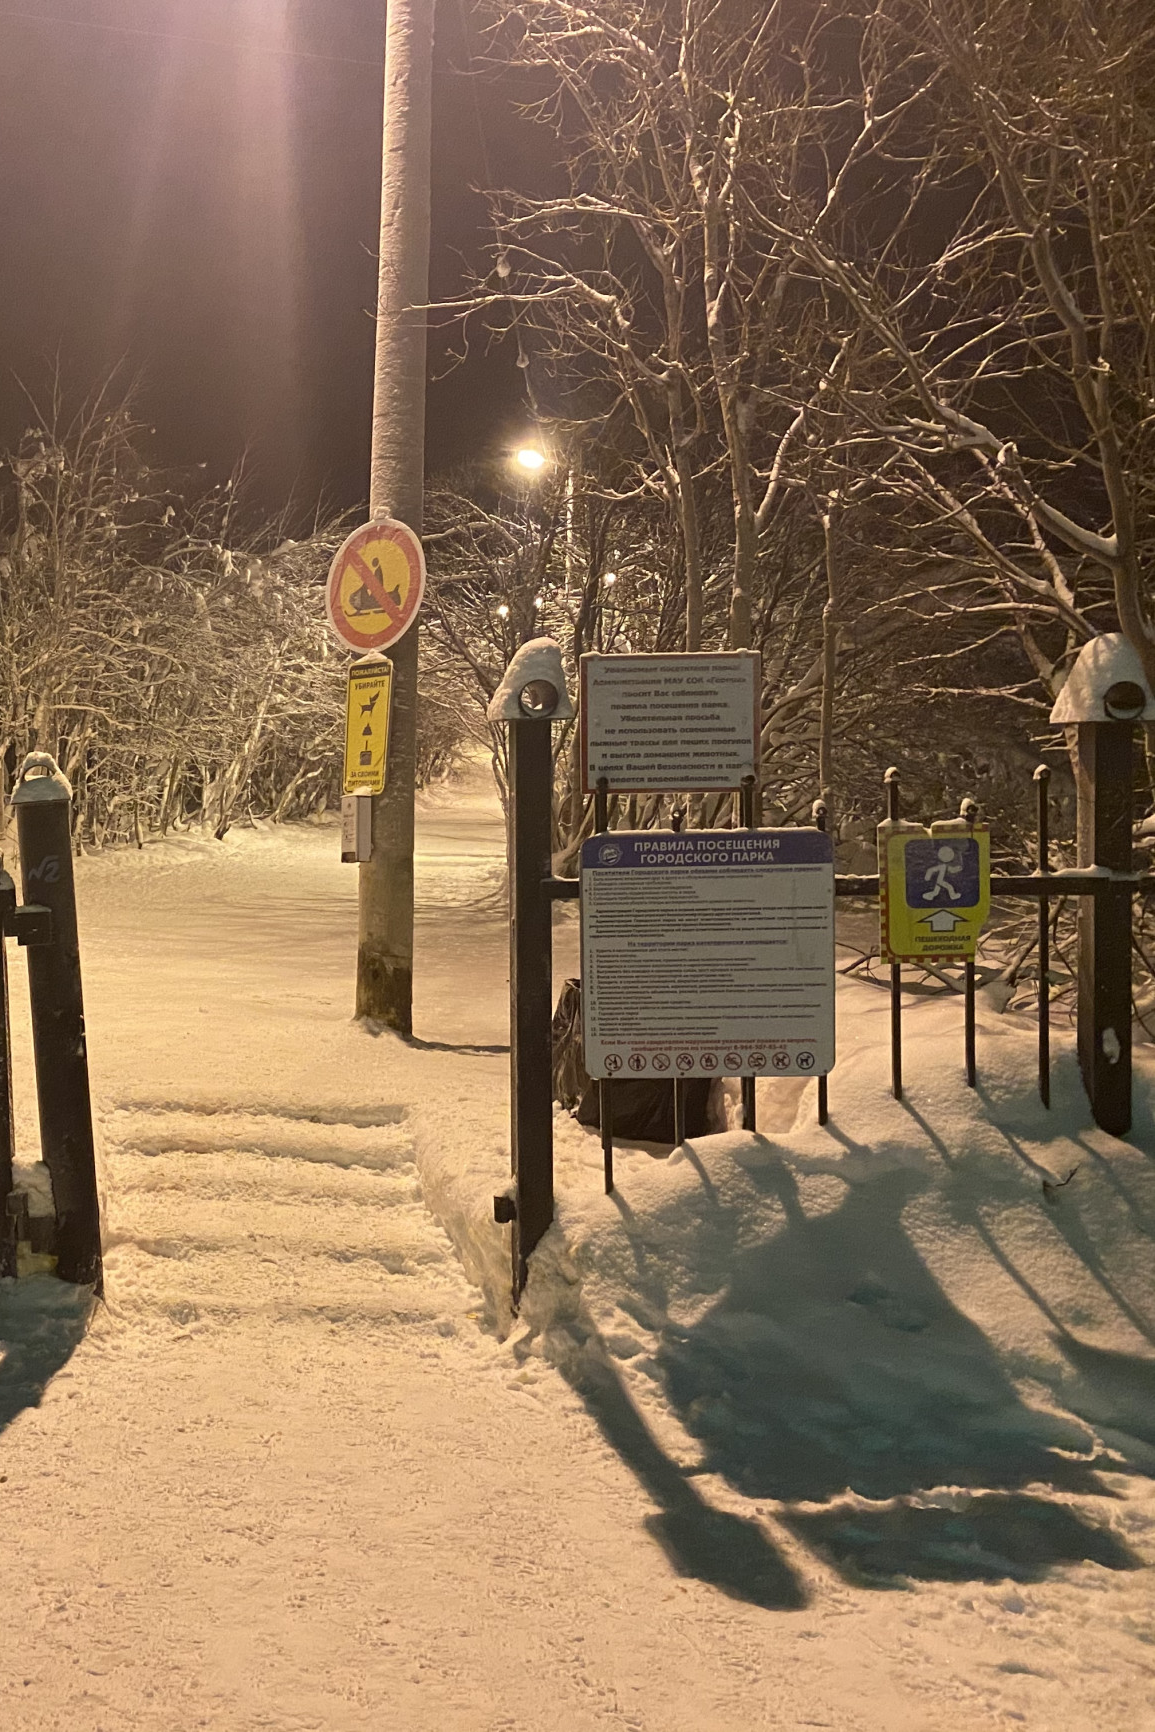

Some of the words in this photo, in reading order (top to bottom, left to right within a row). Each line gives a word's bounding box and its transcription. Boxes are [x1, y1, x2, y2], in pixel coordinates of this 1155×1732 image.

[354, 680, 386, 690] УБИРАЙТЕ
[634, 841, 694, 852] ПРАВИЛА
[698, 839, 780, 851] ПОСЕЩЕНИЯ
[640, 853, 728, 865] ГОРОДСКОГО
[732, 852, 774, 862] ПАРКА
